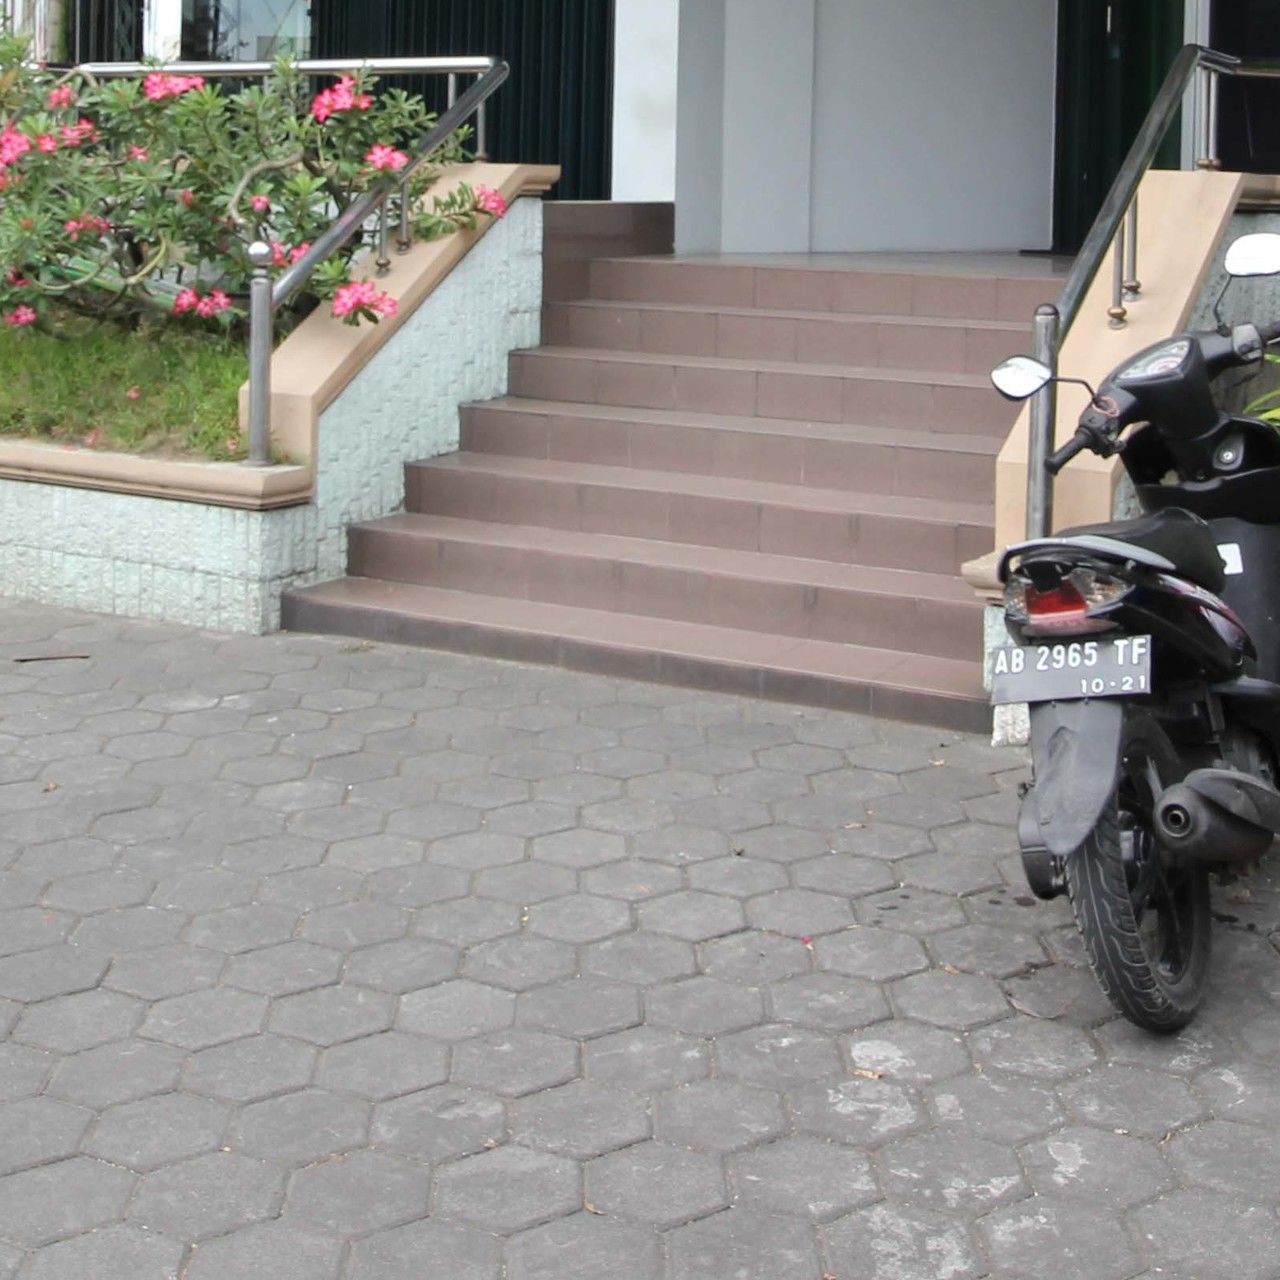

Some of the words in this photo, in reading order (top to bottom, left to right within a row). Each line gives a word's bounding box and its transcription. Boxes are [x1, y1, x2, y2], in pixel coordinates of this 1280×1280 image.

[995, 648, 1025, 674] AB
[1036, 641, 1098, 671] 2965
[1113, 638, 1147, 665] TF
